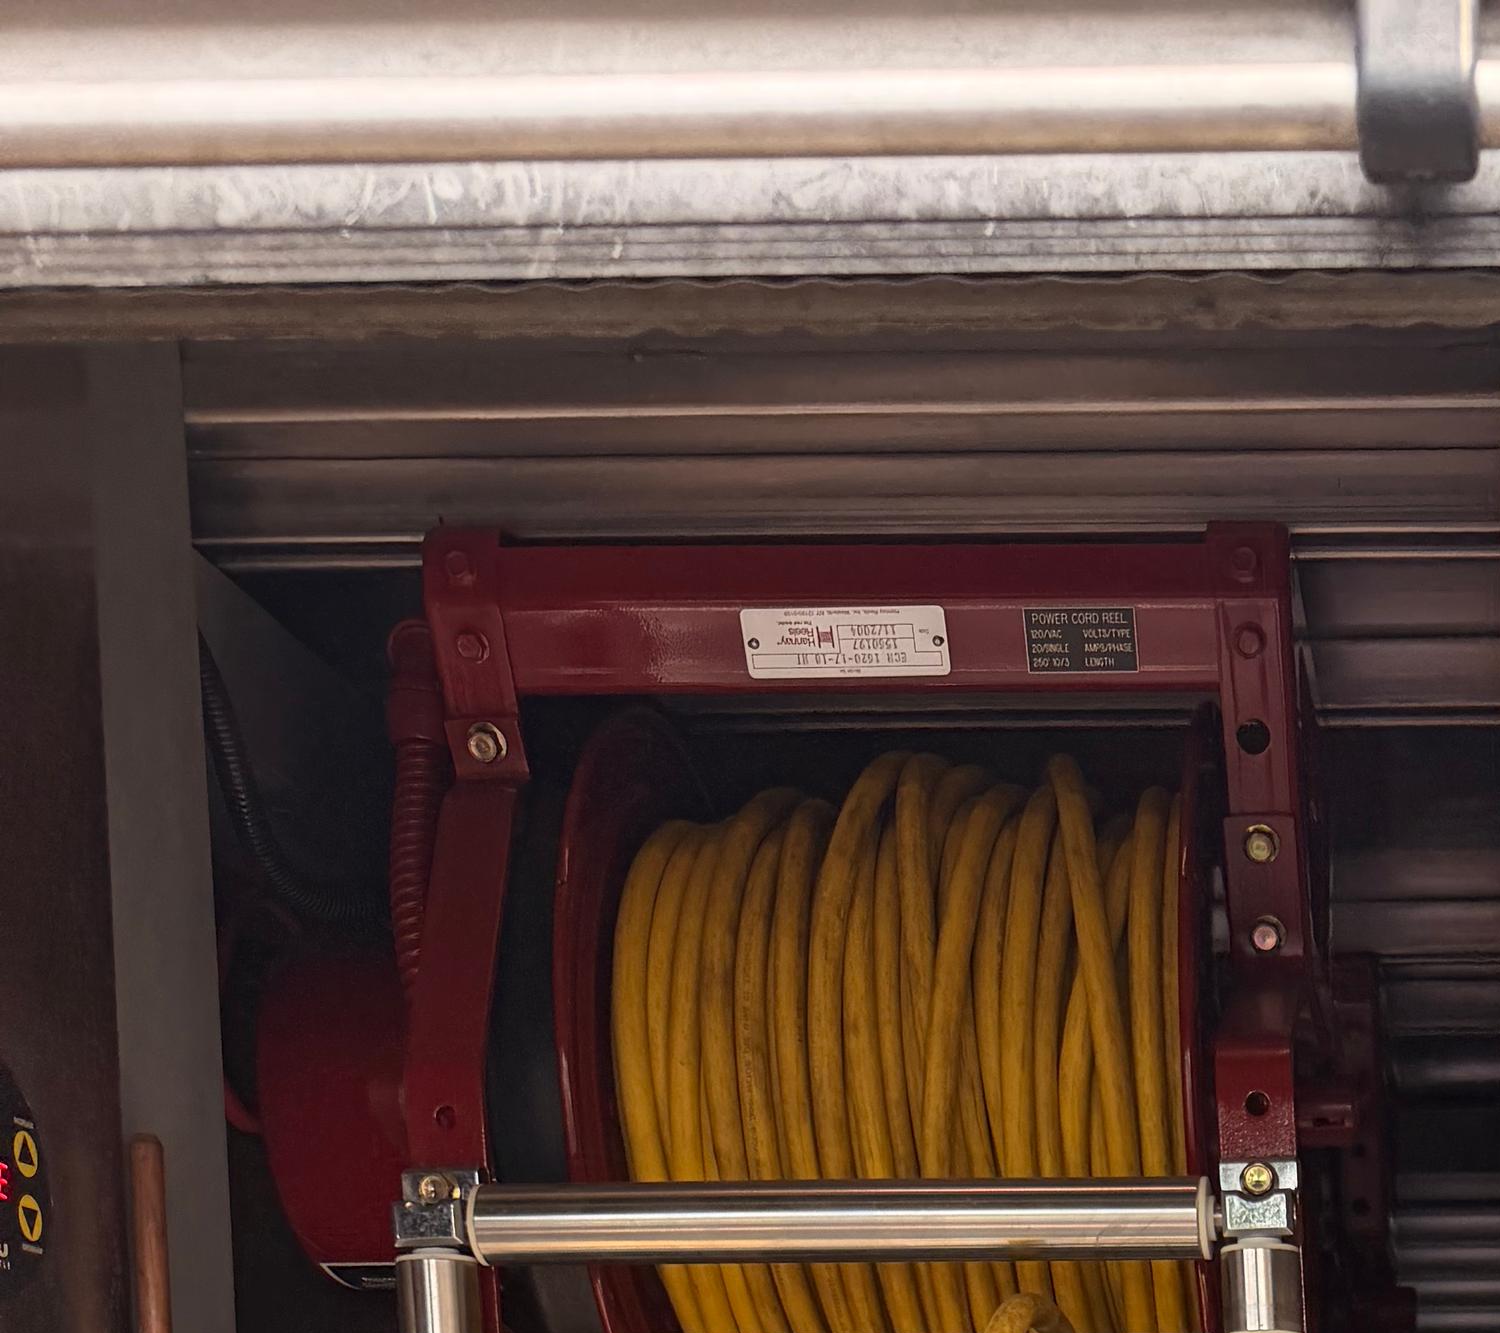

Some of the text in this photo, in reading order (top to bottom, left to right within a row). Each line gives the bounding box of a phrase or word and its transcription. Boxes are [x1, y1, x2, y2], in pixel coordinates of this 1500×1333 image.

[1032, 612, 1128, 624] POWER CORD REEL
